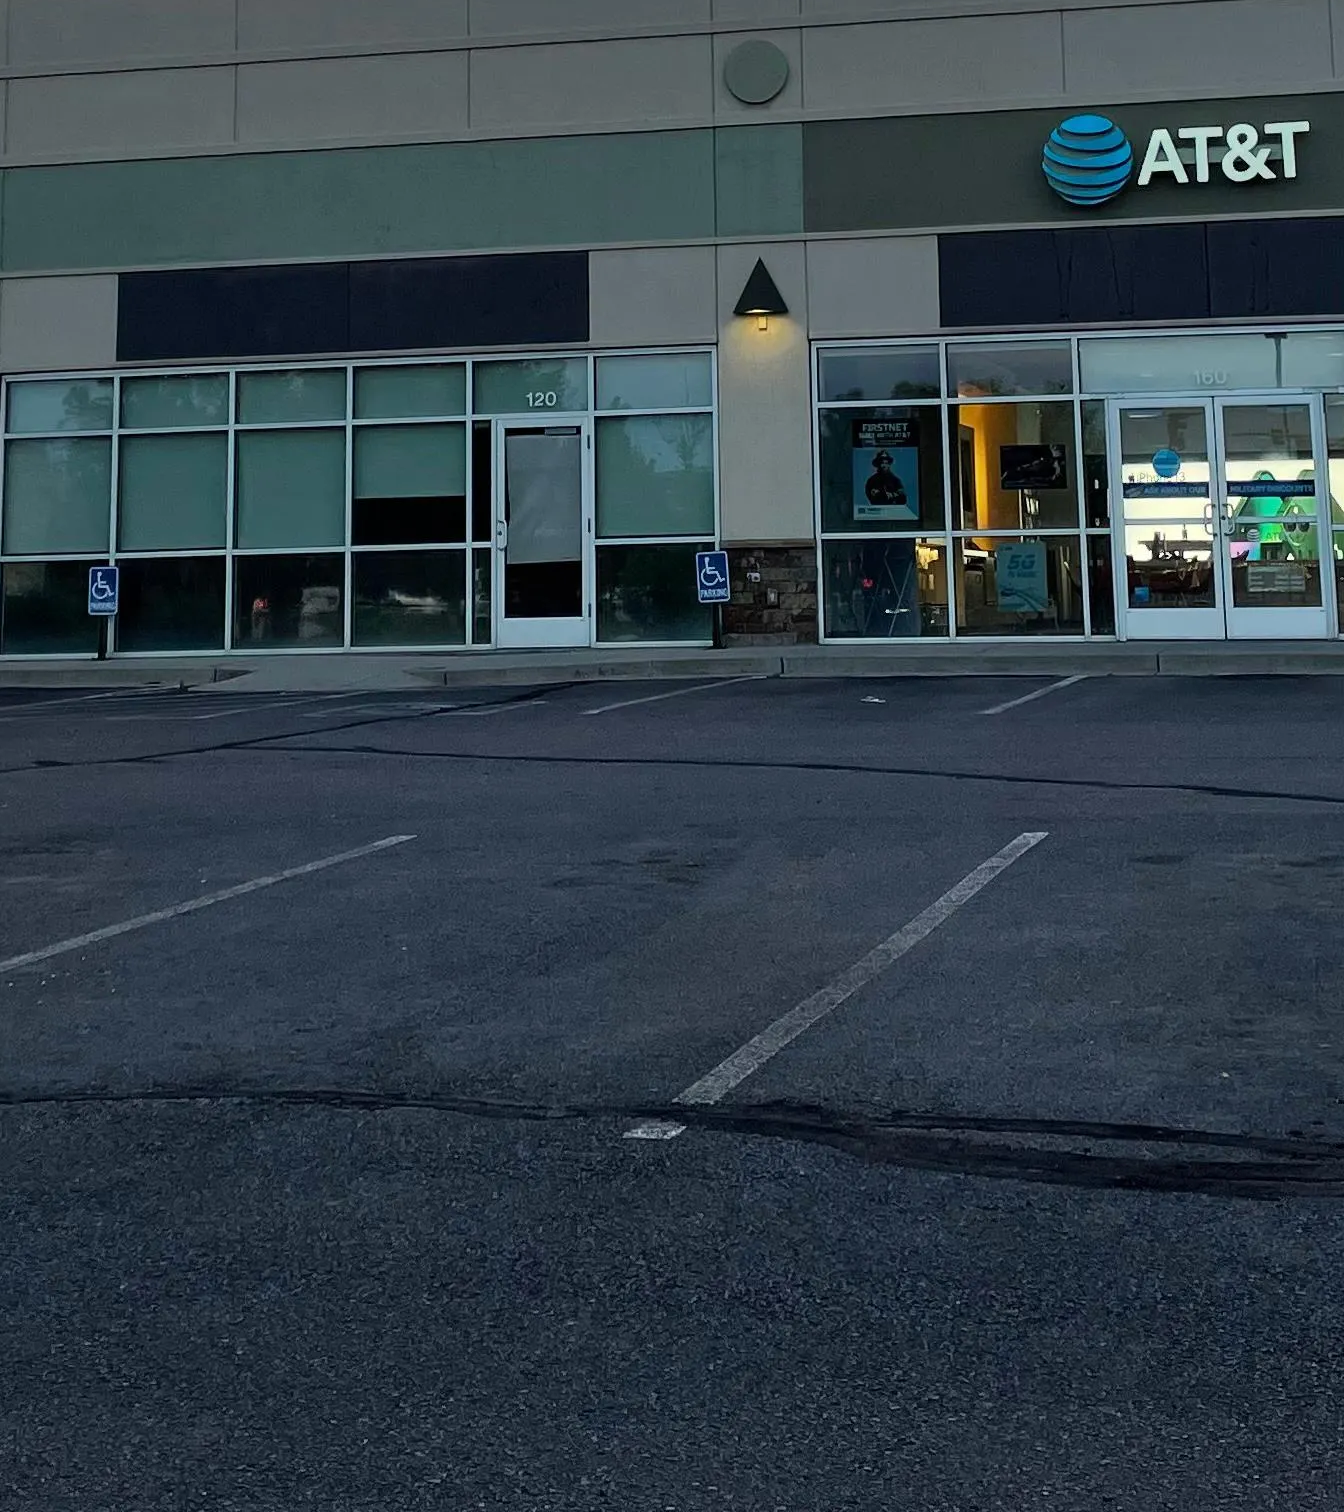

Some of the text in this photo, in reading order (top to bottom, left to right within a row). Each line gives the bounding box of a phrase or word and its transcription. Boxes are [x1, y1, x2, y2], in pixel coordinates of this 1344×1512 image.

[1137, 120, 1311, 186] AT&T
[1193, 369, 1227, 386] 160
[525, 391, 557, 407] 120
